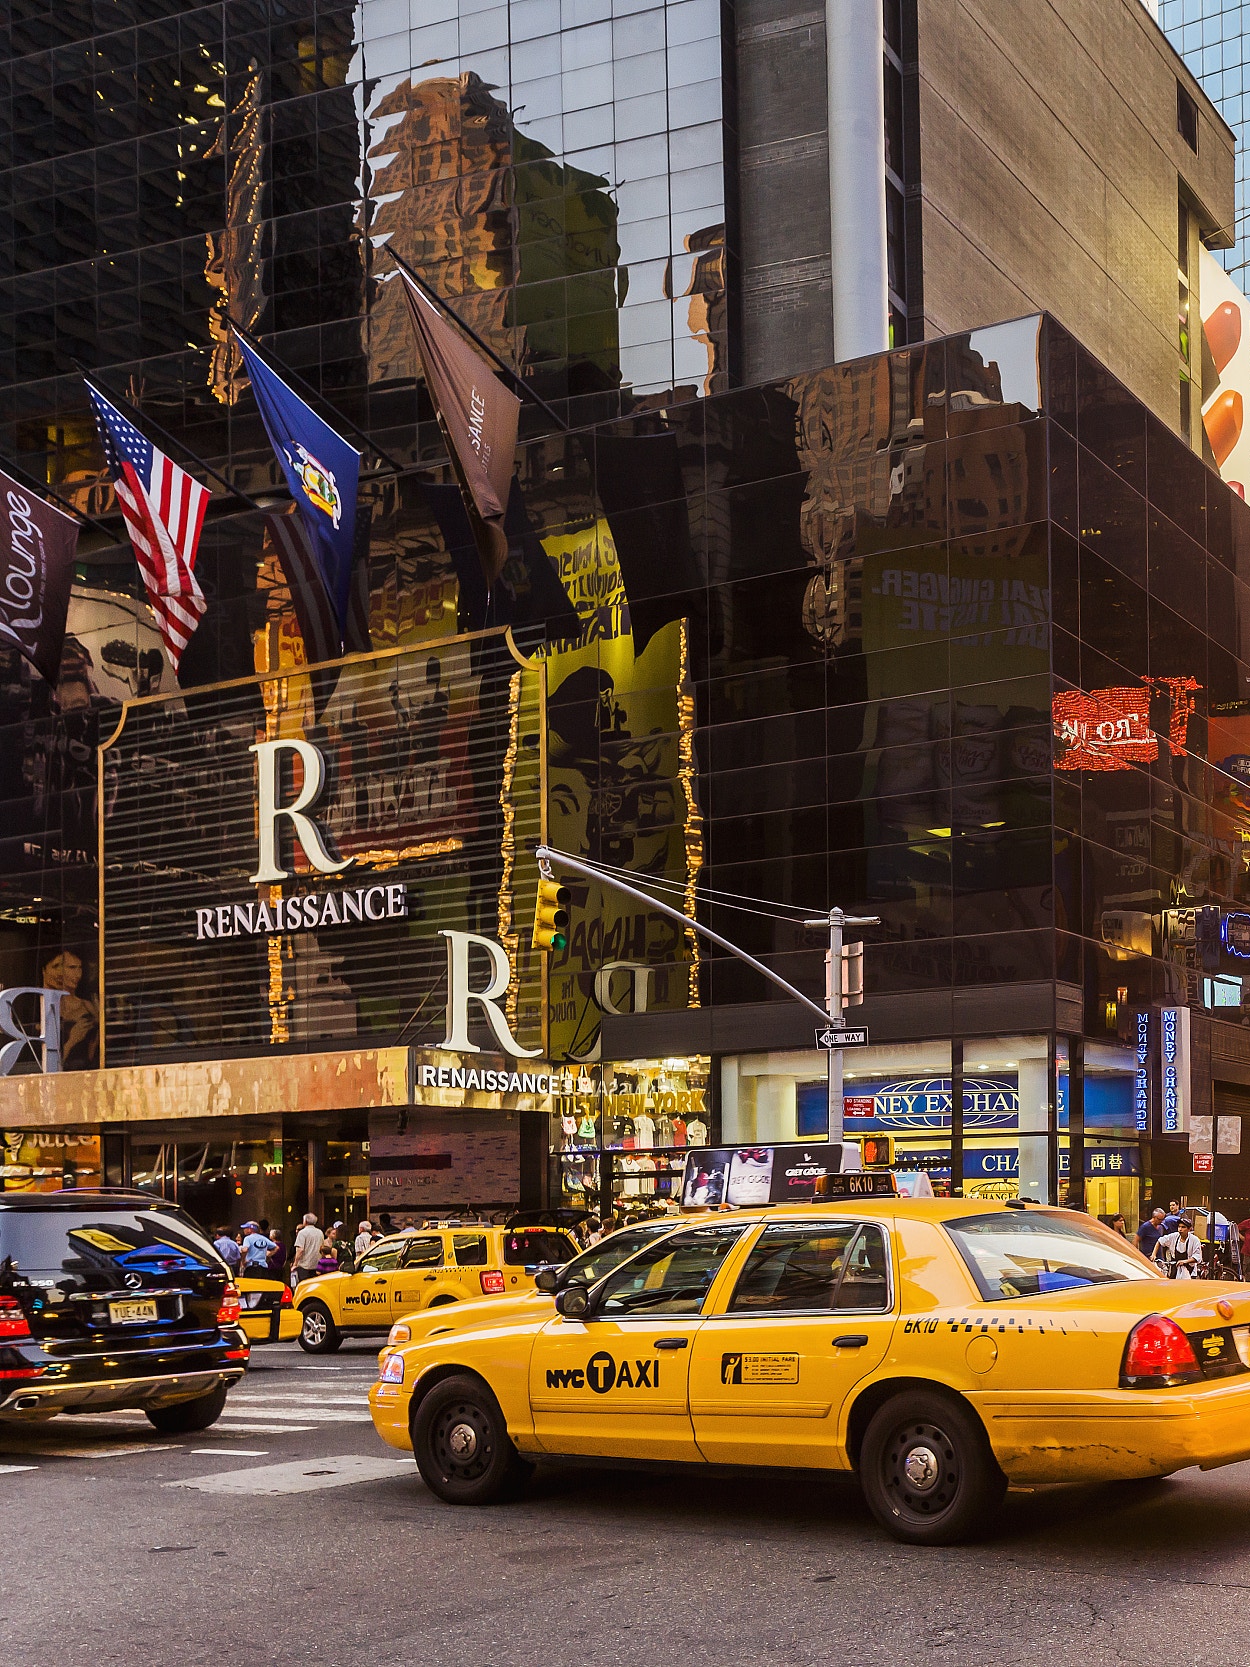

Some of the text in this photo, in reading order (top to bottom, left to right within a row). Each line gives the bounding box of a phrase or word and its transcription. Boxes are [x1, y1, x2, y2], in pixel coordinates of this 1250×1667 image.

[249, 738, 355, 884] R
[196, 884, 406, 939] RENAISSANCE
[437, 930, 544, 1057] R
[824, 1032, 862, 1044] ONE WAY
[1162, 1010, 1178, 1130] MONEY CHANGE
[420, 1065, 559, 1096] RENAISSANCE
[553, 1097, 601, 1118] JUST
[604, 1094, 647, 1116] NEW
[652, 1088, 707, 1113] YORK
[874, 1092, 1065, 1114] NEY EXCHANE
[981, 1154, 1070, 1173] CHAE
[1090, 1153, 1123, 1170] 両替
[850, 1176, 873, 1193] 6K10
[876, 1184, 889, 1192] DUTY
[31, 1279, 55, 1287] 350
[345, 1289, 387, 1306] NYC TAXI
[903, 1317, 939, 1334] 6K10
[545, 1350, 661, 1394] NYC TAXI
